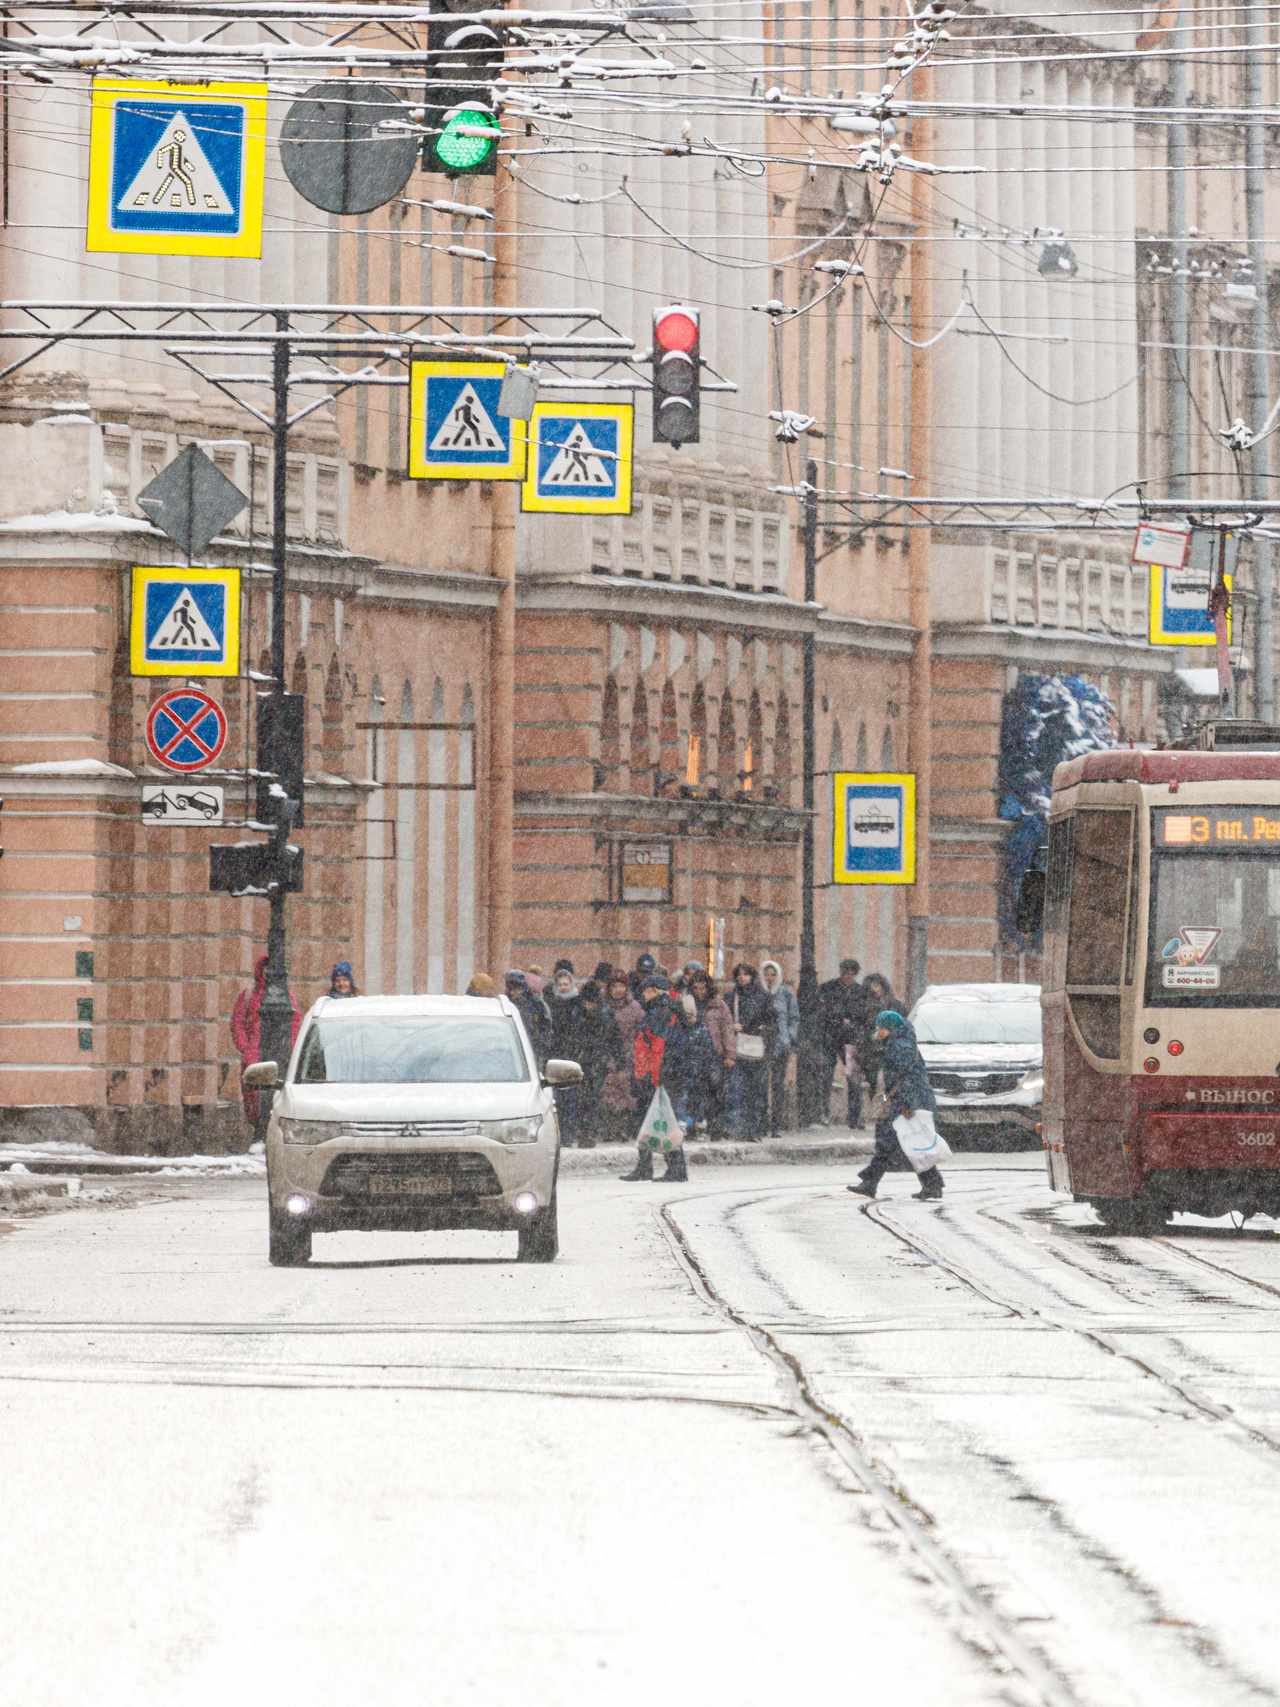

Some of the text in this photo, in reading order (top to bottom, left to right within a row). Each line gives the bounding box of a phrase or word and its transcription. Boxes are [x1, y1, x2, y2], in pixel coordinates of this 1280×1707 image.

[1191, 816, 1210, 842] 3
[1216, 820, 1249, 840] пл.
[1200, 1089, 1274, 1103] ВЫНОС
[1237, 1131, 1276, 1146] 3602
